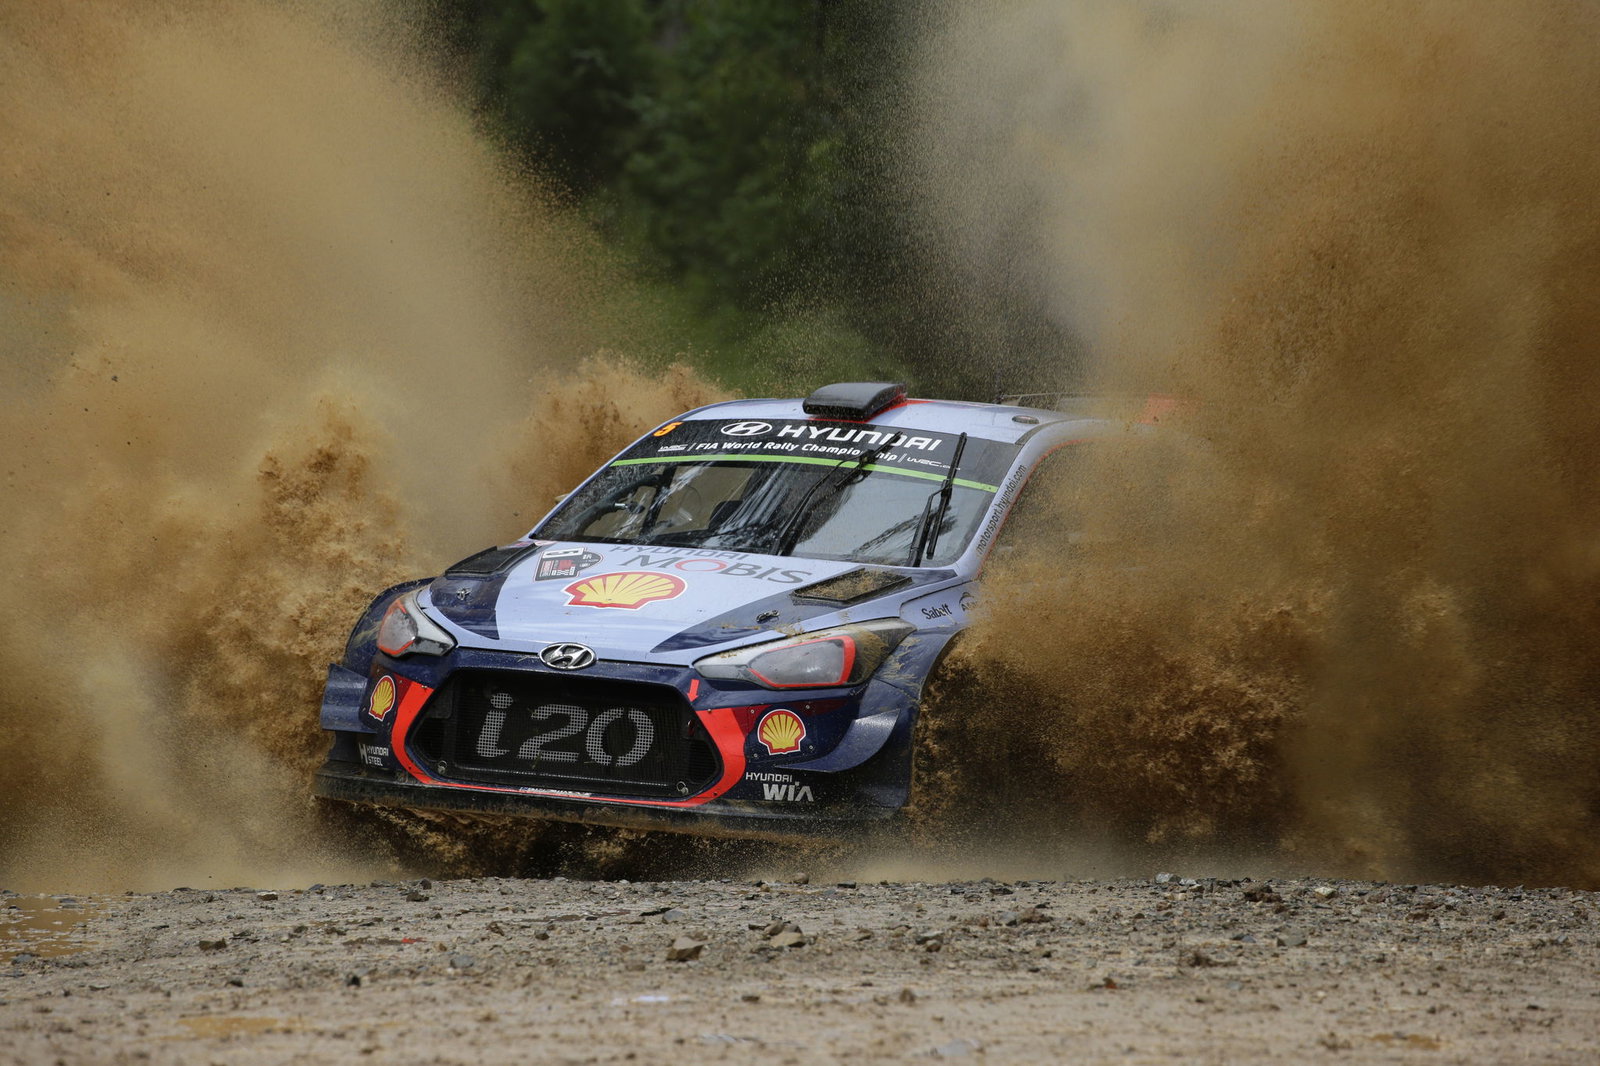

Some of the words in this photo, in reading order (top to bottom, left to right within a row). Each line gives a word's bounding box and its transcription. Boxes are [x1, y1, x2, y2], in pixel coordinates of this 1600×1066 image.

[653, 421, 683, 437] 5
[778, 424, 942, 451] HYUNDAI
[695, 442, 718, 450] FIA
[721, 441, 762, 450] World
[765, 442, 799, 452] Rally
[802, 443, 898, 462] Champiohip
[975, 464, 1027, 555] motorsport.hyundai.com
[609, 545, 751, 561] HYUNDAI
[620, 553, 812, 584] MOBIS
[476, 693, 655, 767] i20
[366, 745, 389, 757] HYUNDAI
[368, 755, 384, 767] STEEL
[745, 771, 793, 782] HYUNDAI
[762, 781, 814, 801] WIA
